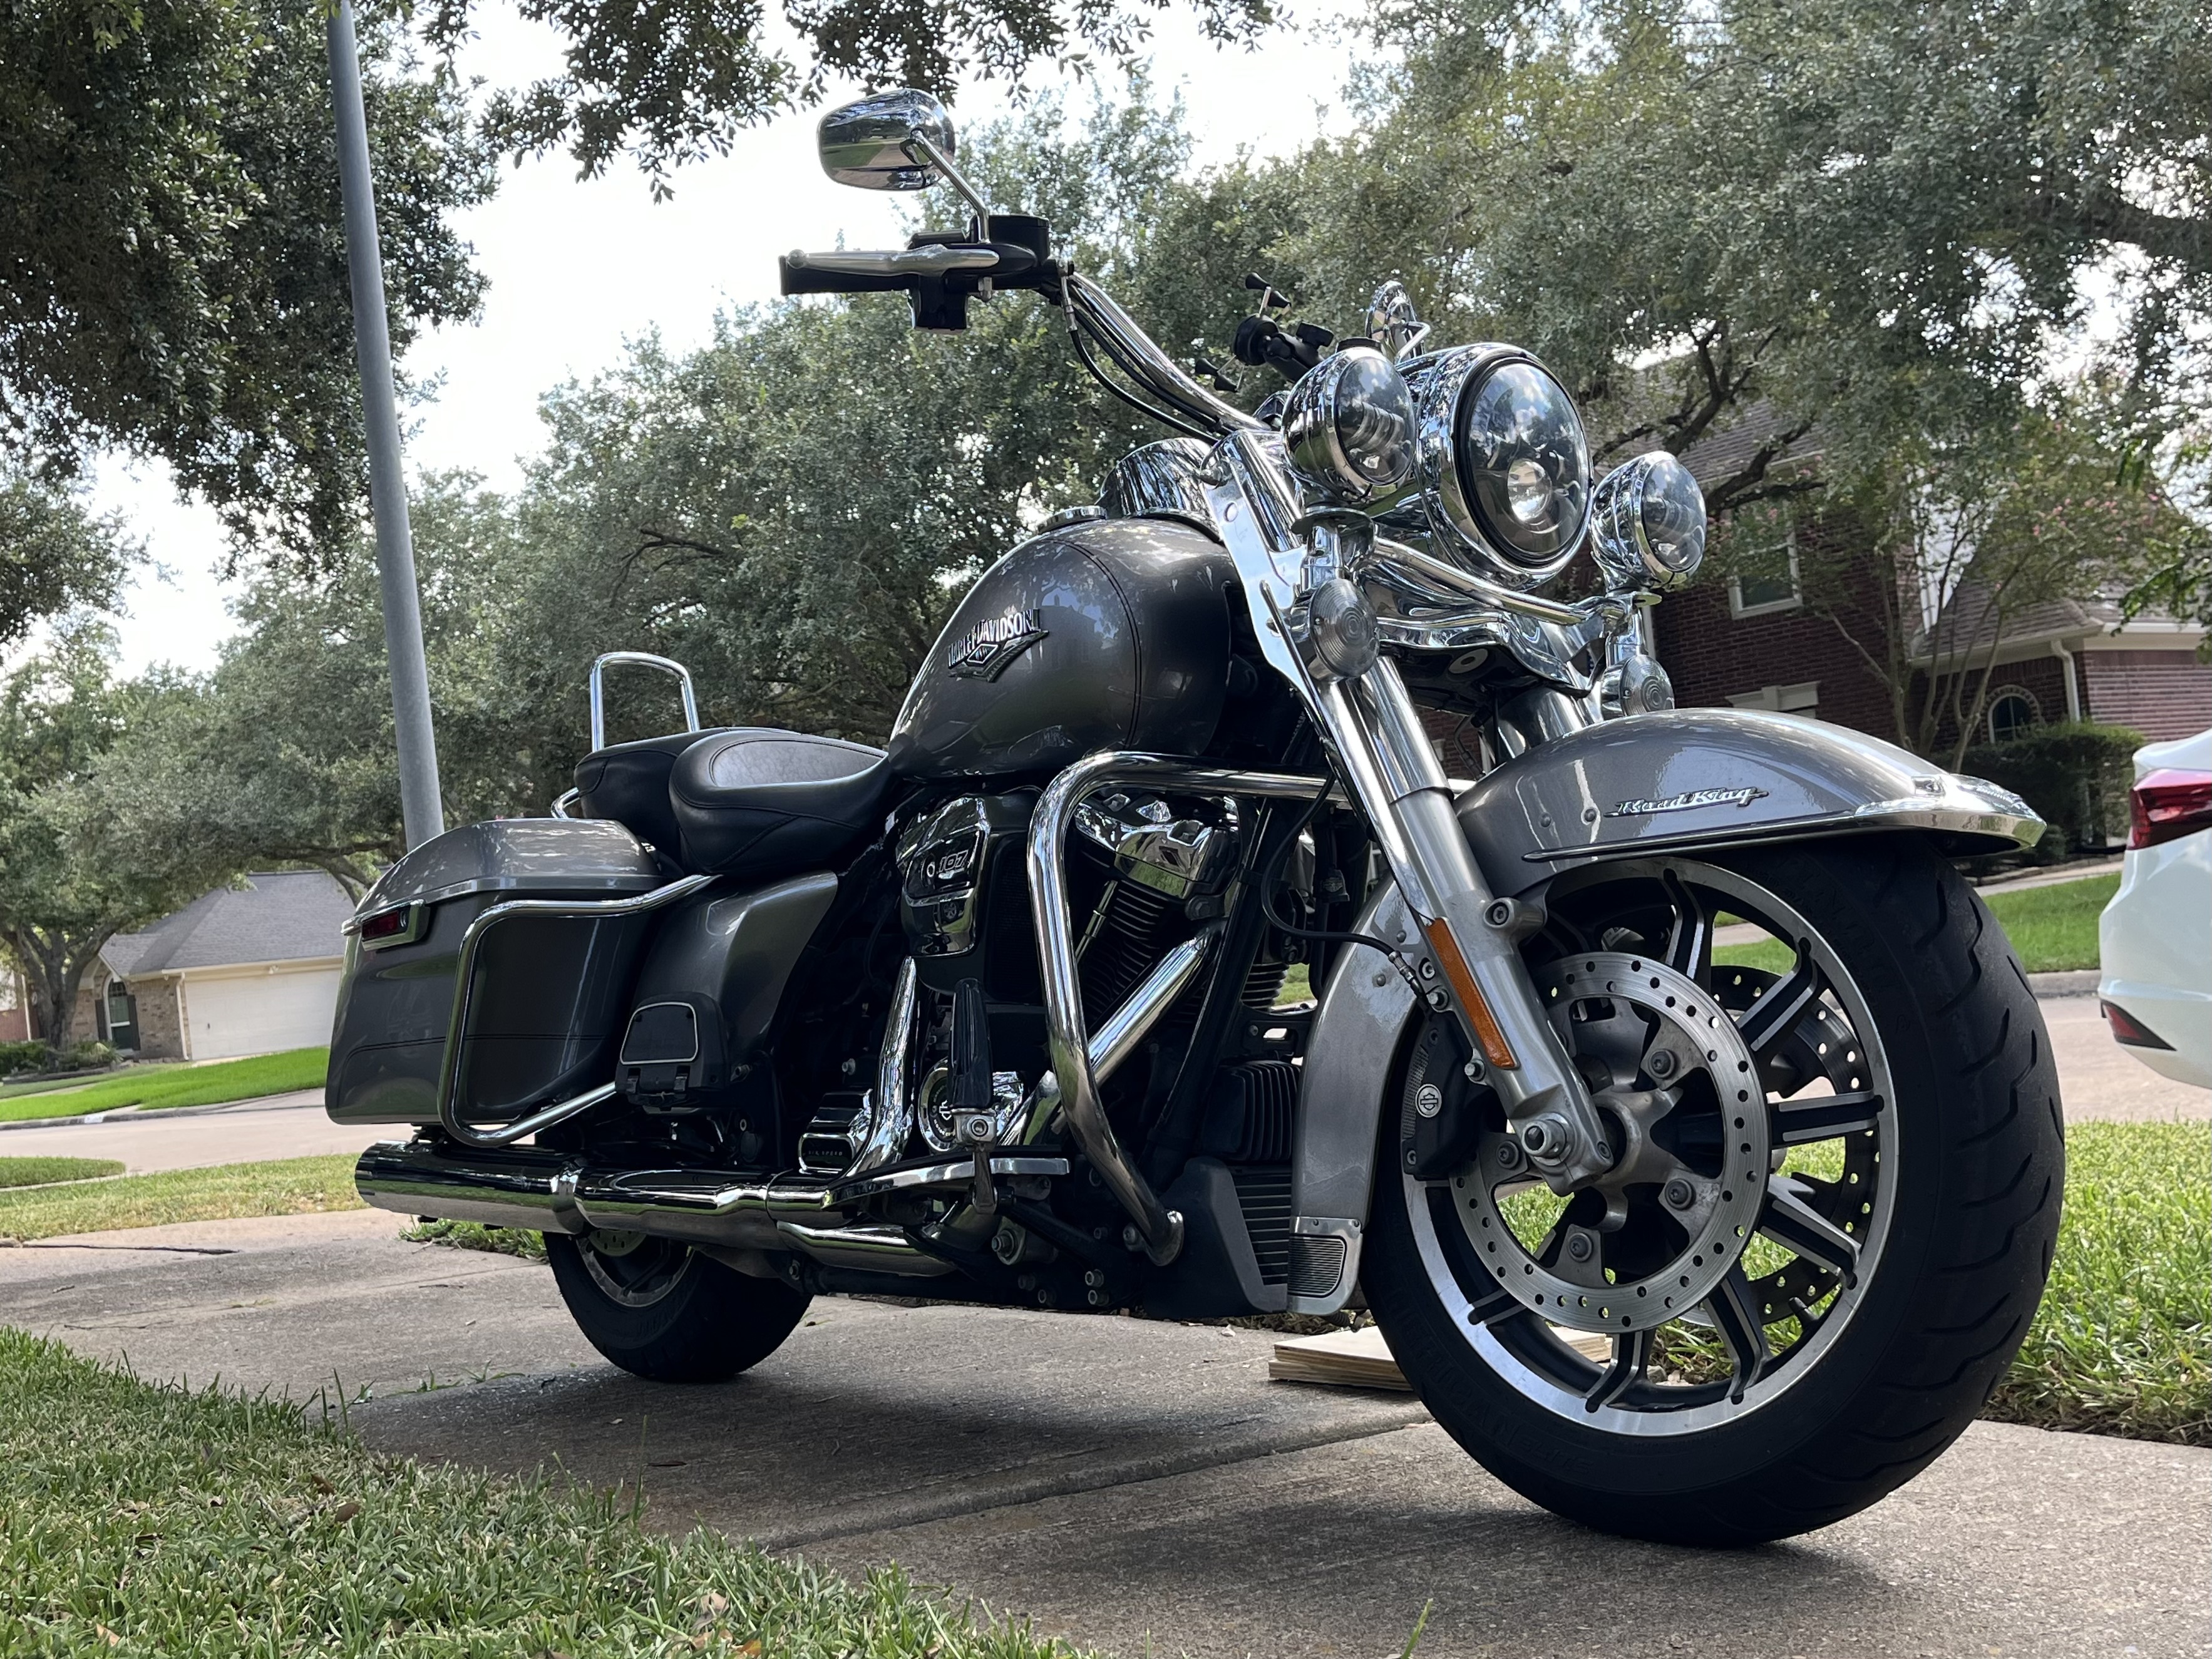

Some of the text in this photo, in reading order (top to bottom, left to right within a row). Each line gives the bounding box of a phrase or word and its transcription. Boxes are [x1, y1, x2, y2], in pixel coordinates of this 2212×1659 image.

[1613, 786, 1769, 815] Road King
[938, 849, 969, 873] 107
